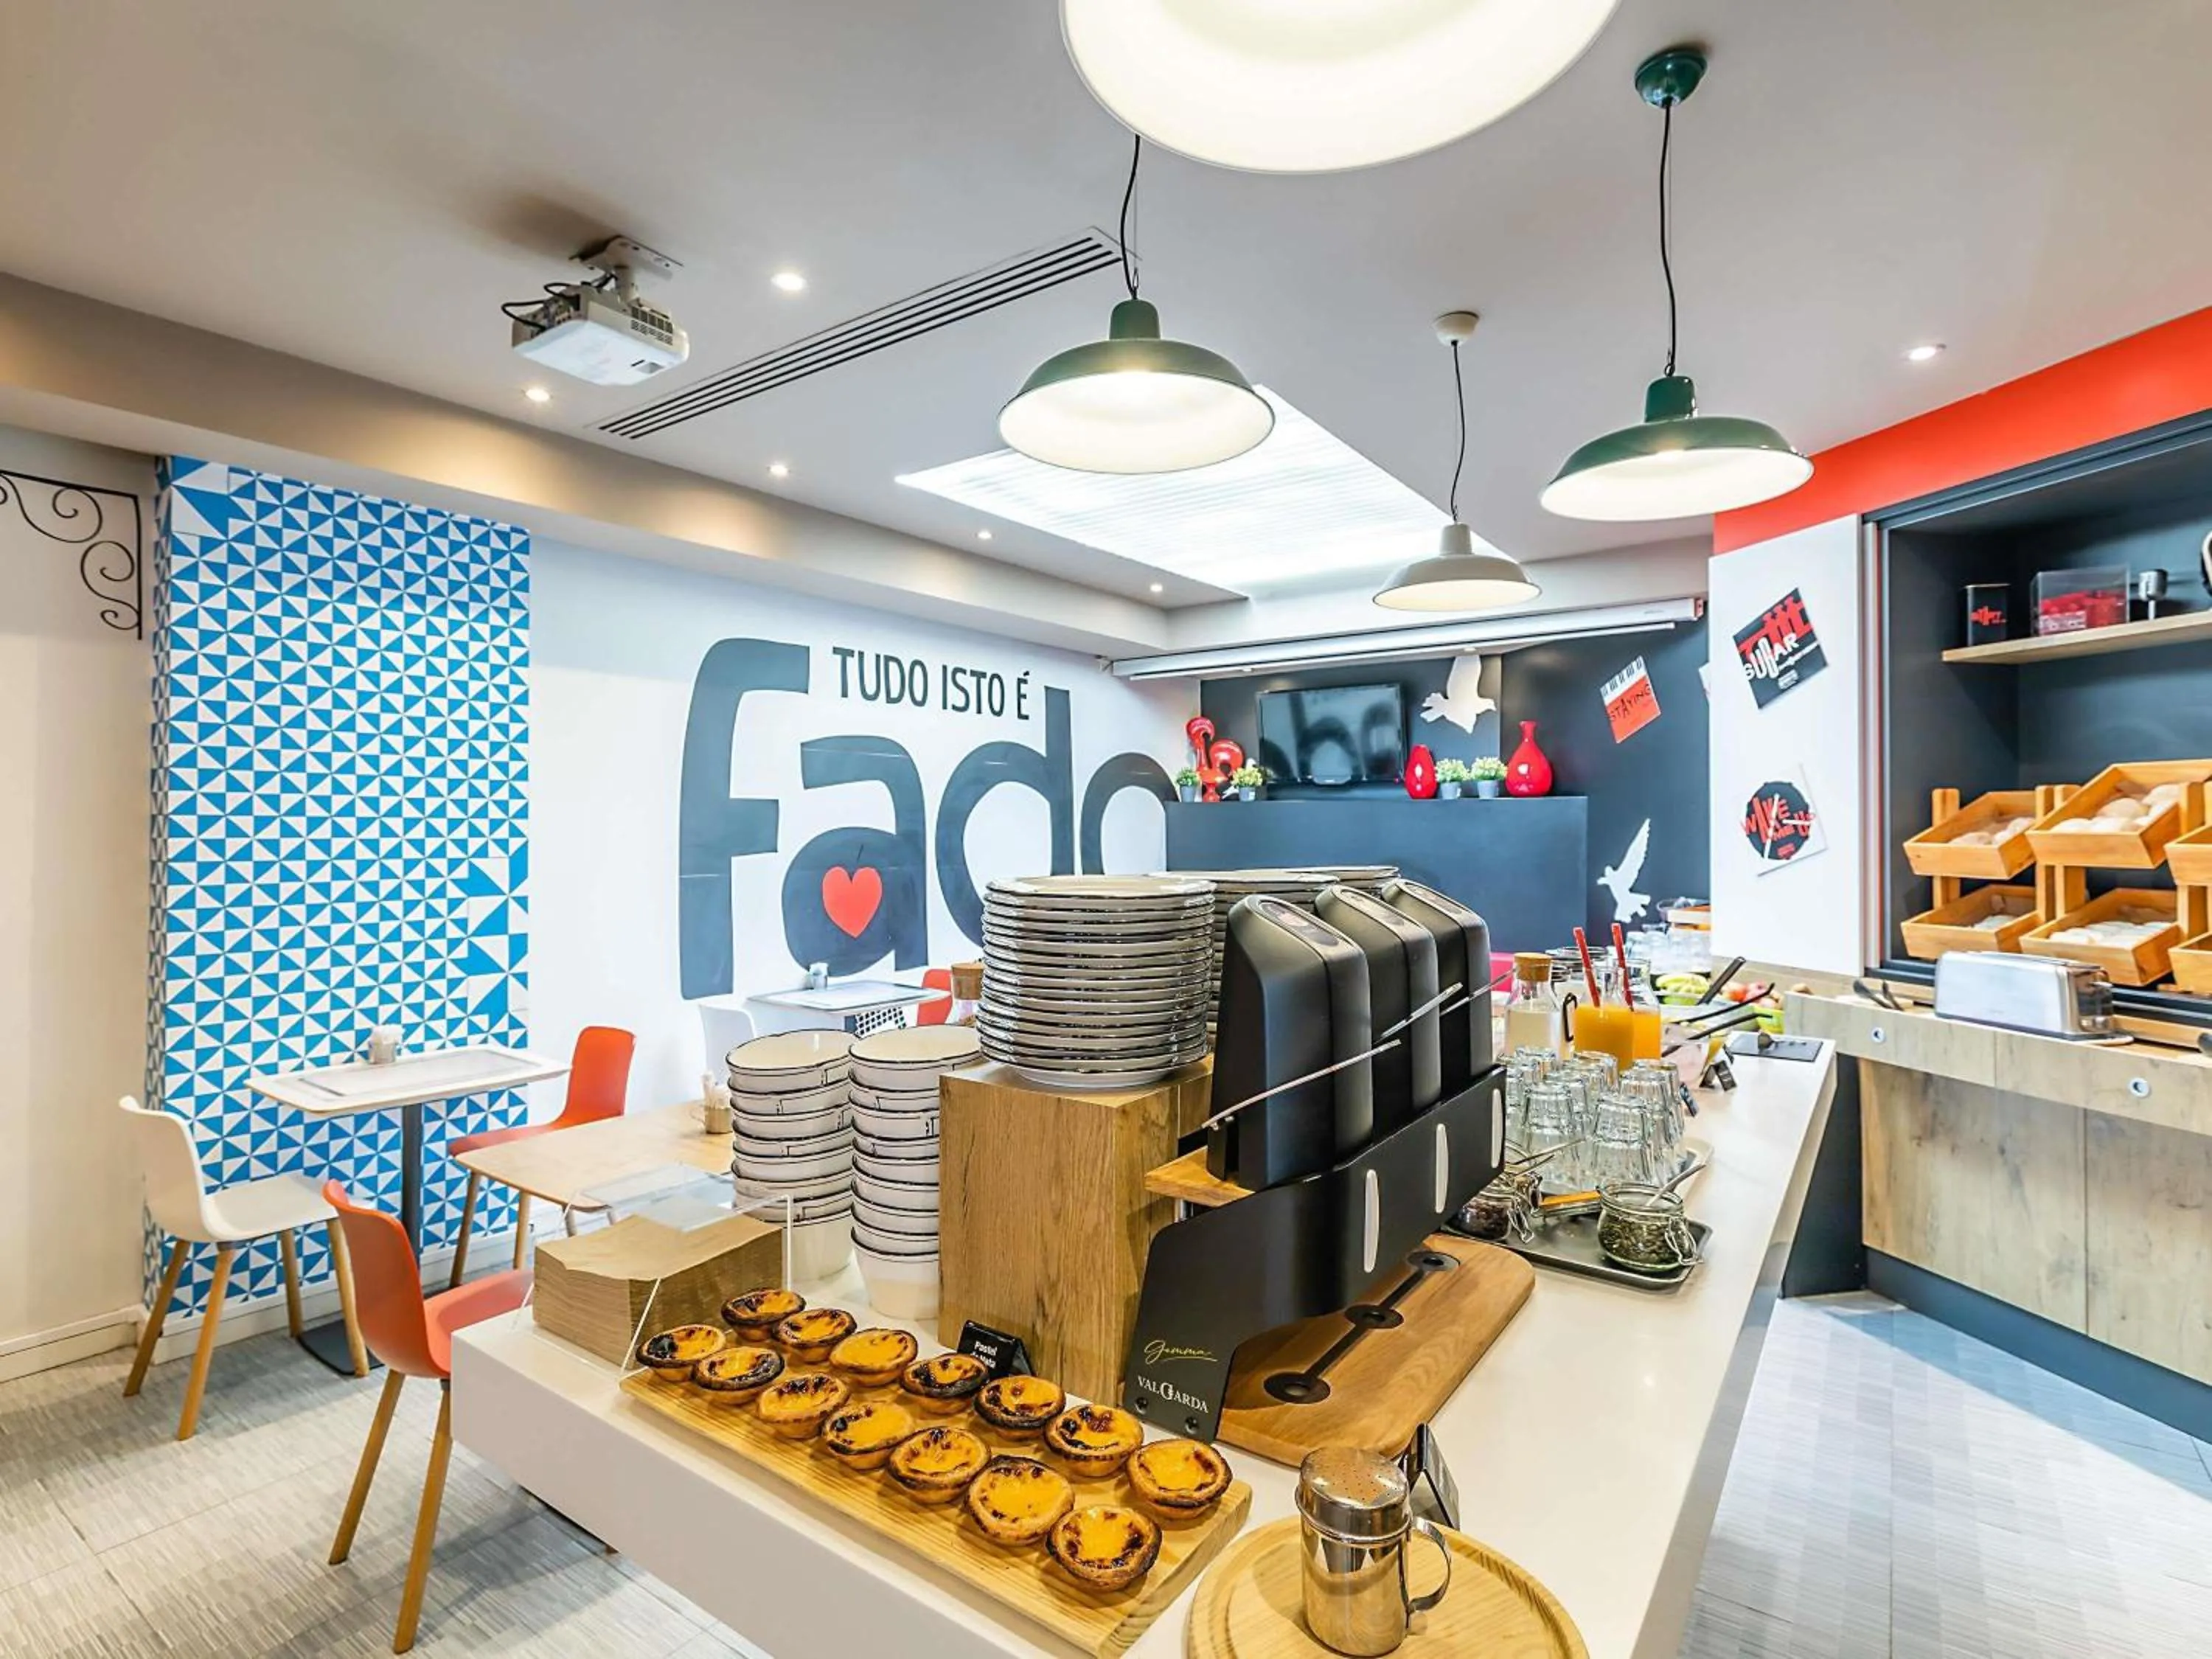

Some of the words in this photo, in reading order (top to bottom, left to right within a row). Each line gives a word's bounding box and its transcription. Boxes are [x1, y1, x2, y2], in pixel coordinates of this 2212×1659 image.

[832, 646, 928, 708] TUDO
[942, 664, 1006, 718] ISTO
[1015, 670, 1031, 720] É
